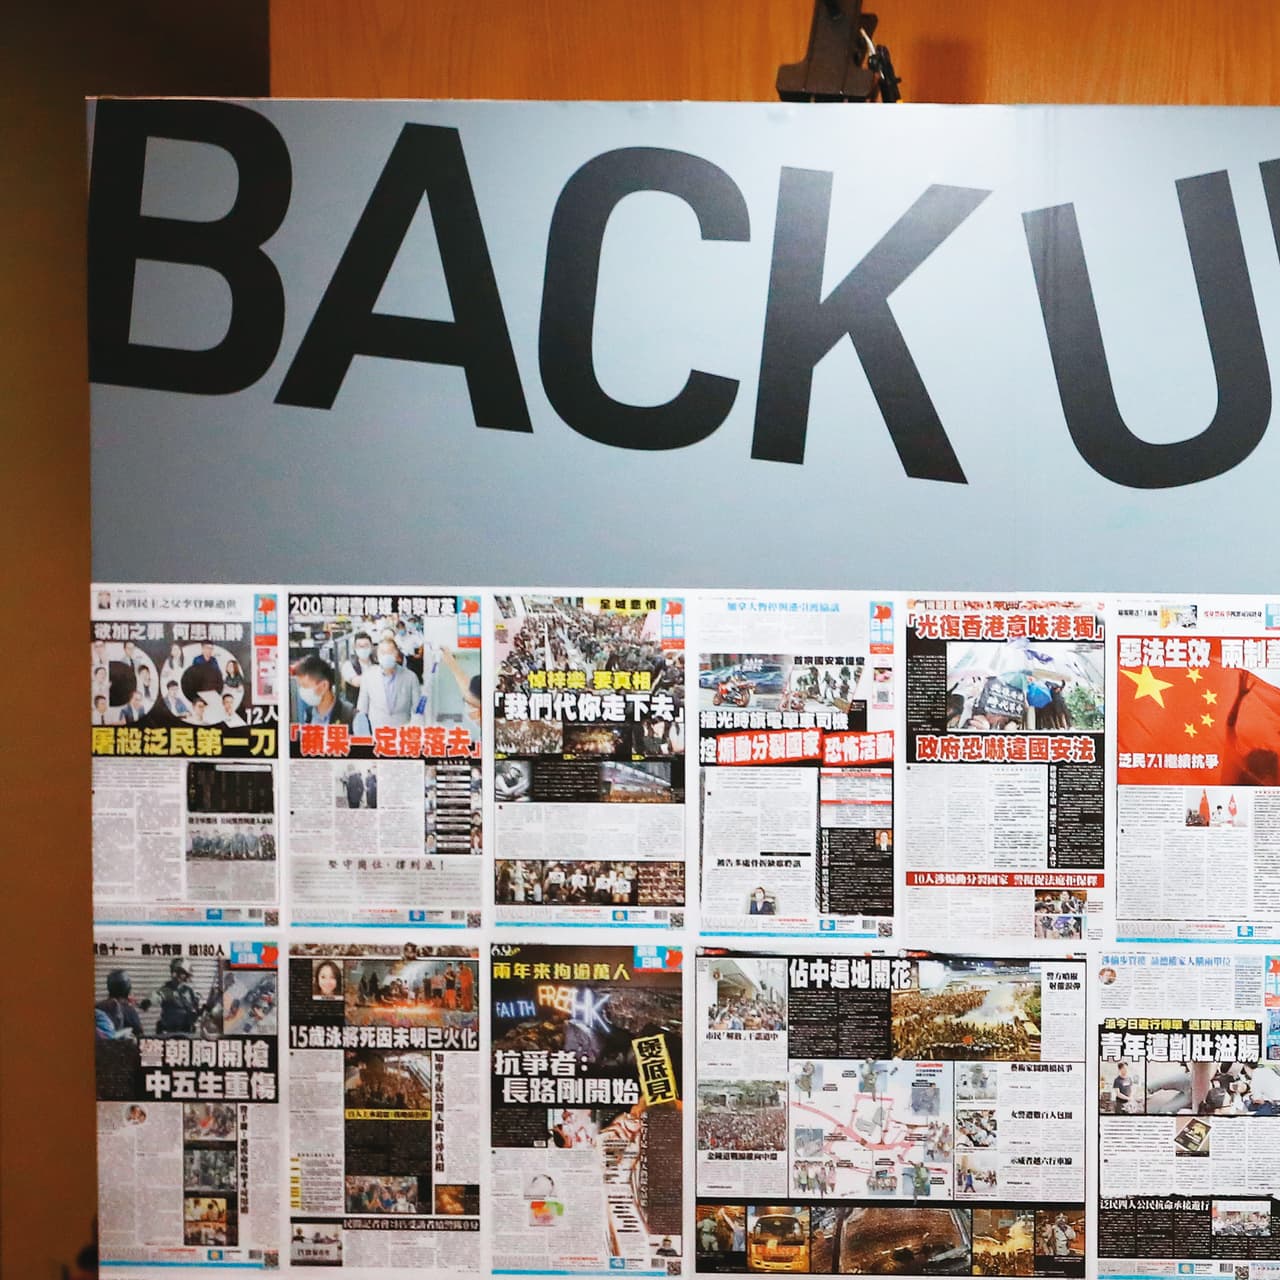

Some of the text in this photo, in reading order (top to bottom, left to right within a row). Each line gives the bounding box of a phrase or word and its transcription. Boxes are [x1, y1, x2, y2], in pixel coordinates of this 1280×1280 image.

[87, 100, 991, 486] BACK
[494, 692, 685, 722] 「我們代你走下去」
[92, 727, 275, 757] 屠殺泛民第一刀
[916, 735, 1096, 762] 政府恐嚇違國安法
